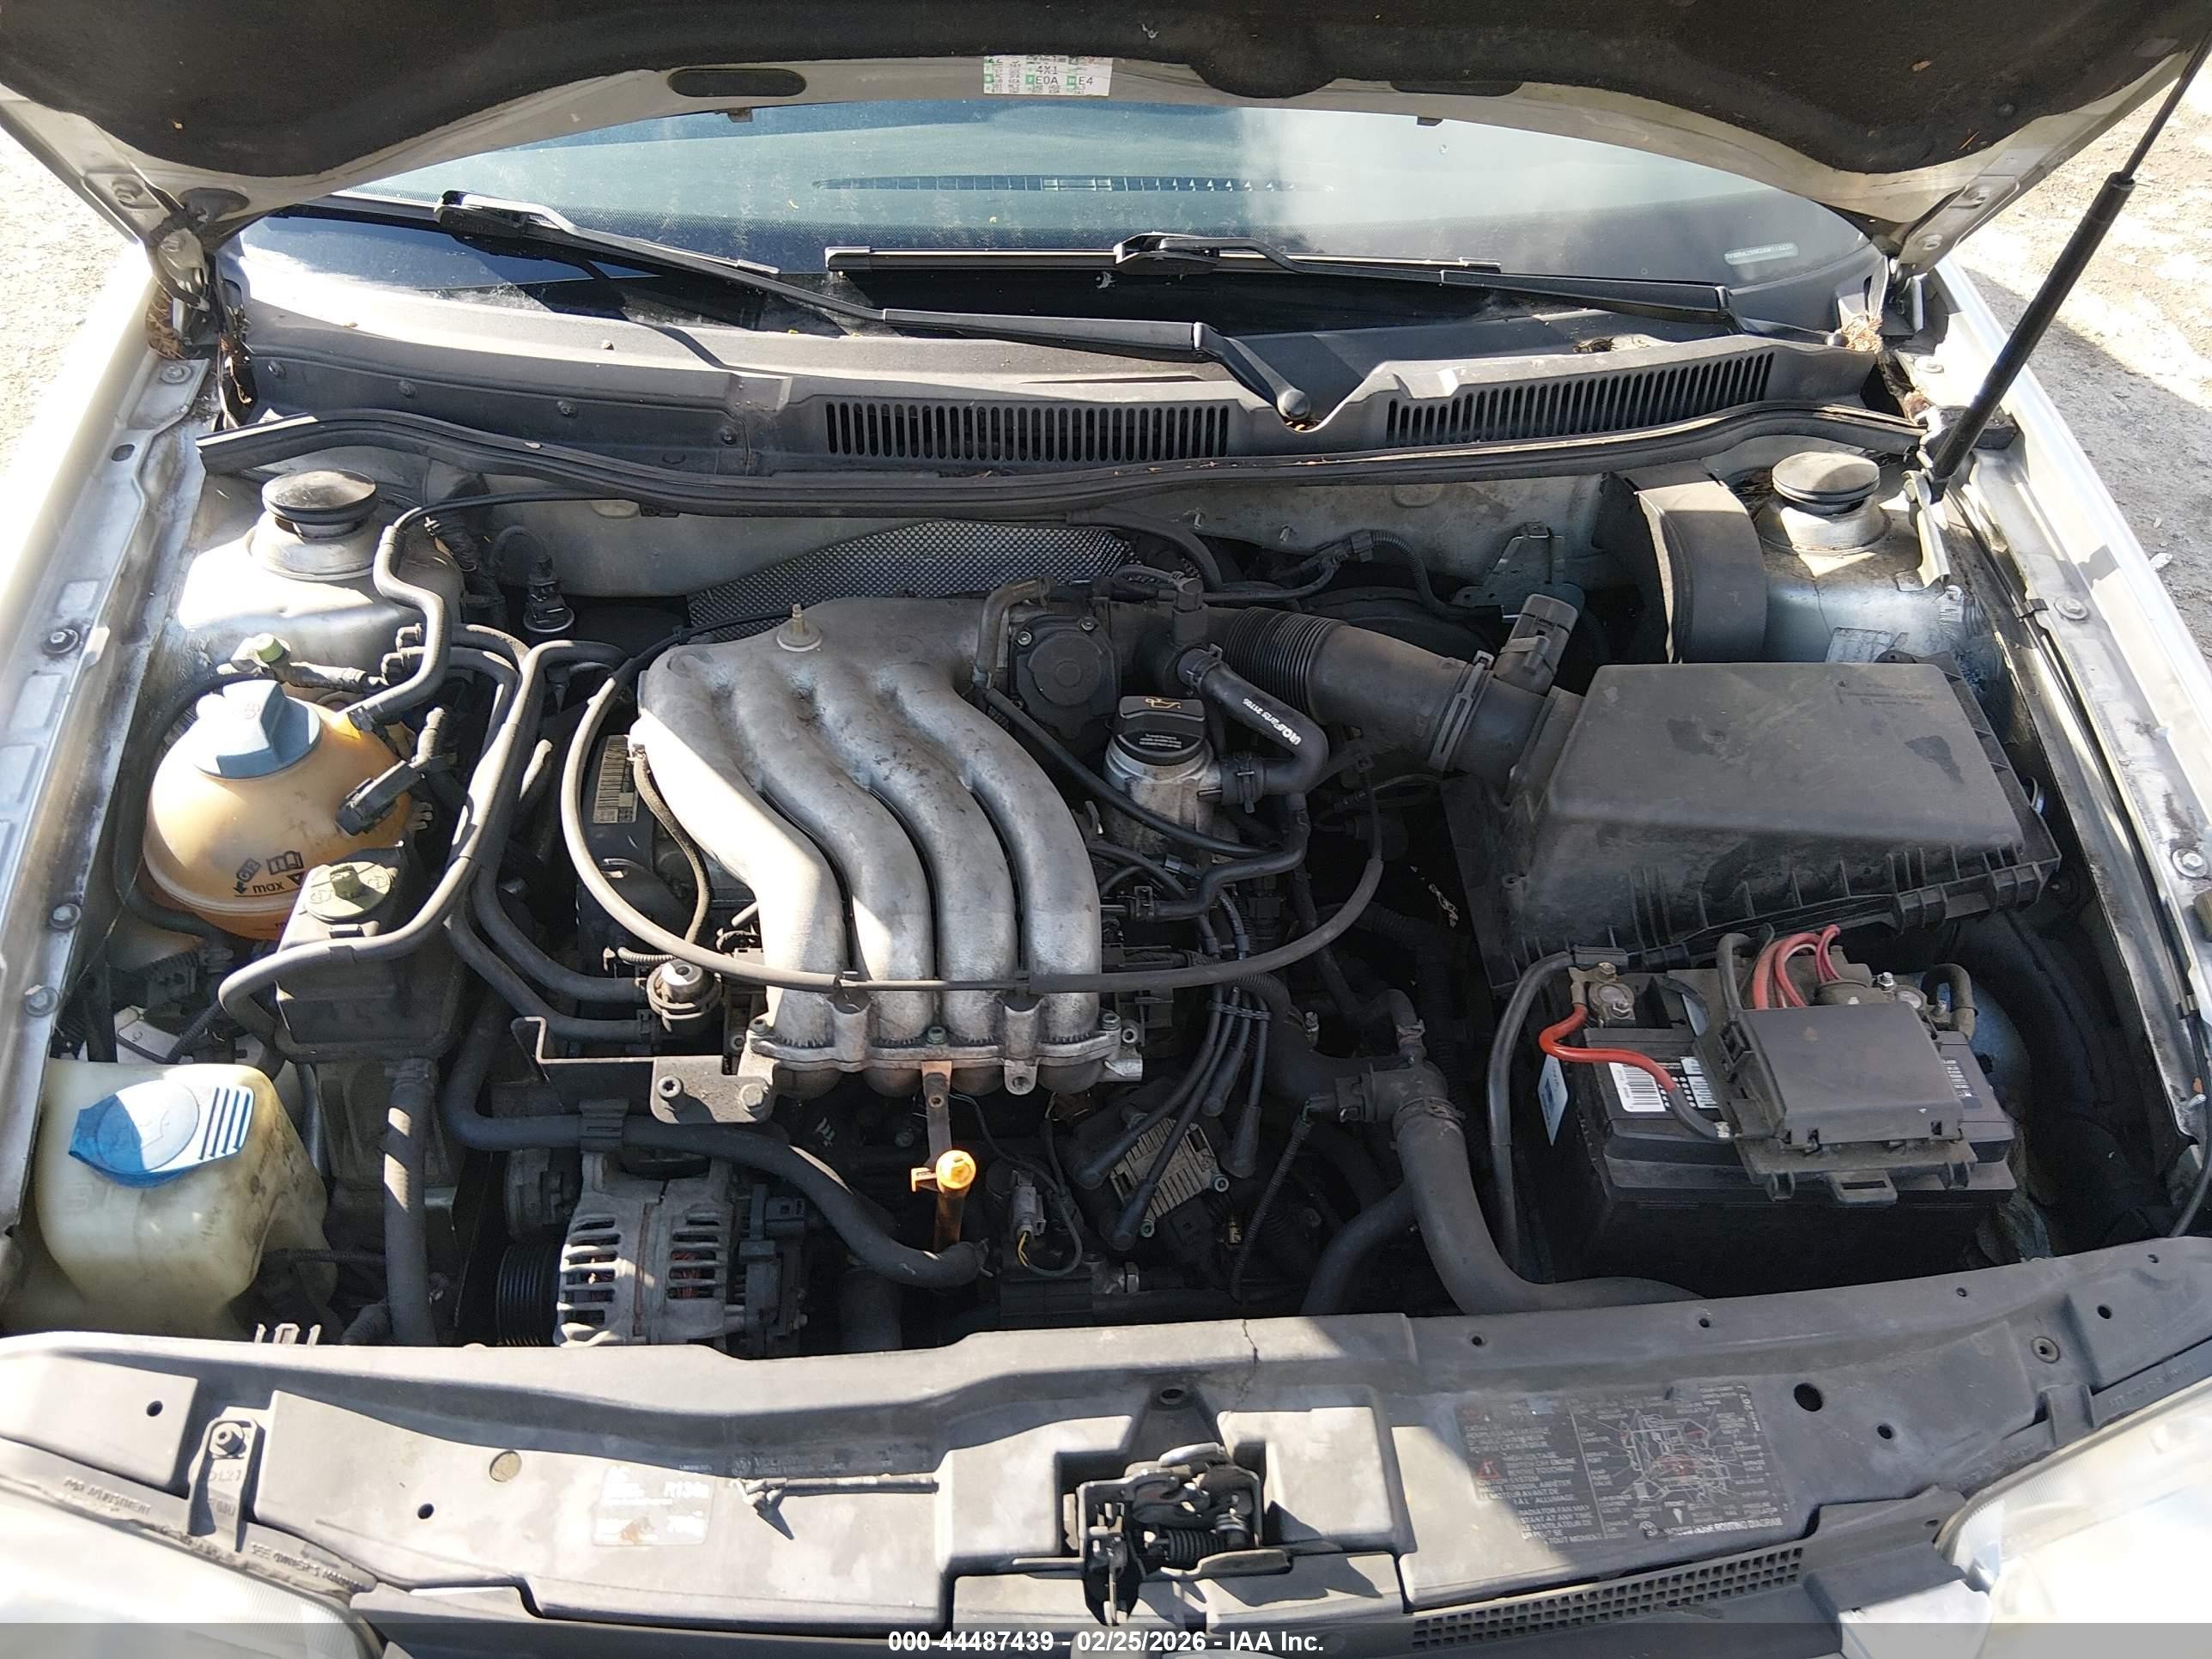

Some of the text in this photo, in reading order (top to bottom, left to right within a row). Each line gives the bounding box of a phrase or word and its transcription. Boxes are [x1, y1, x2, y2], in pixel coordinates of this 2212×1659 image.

[1036, 76, 1093, 85] E0A E4
[252, 882, 285, 893] max
